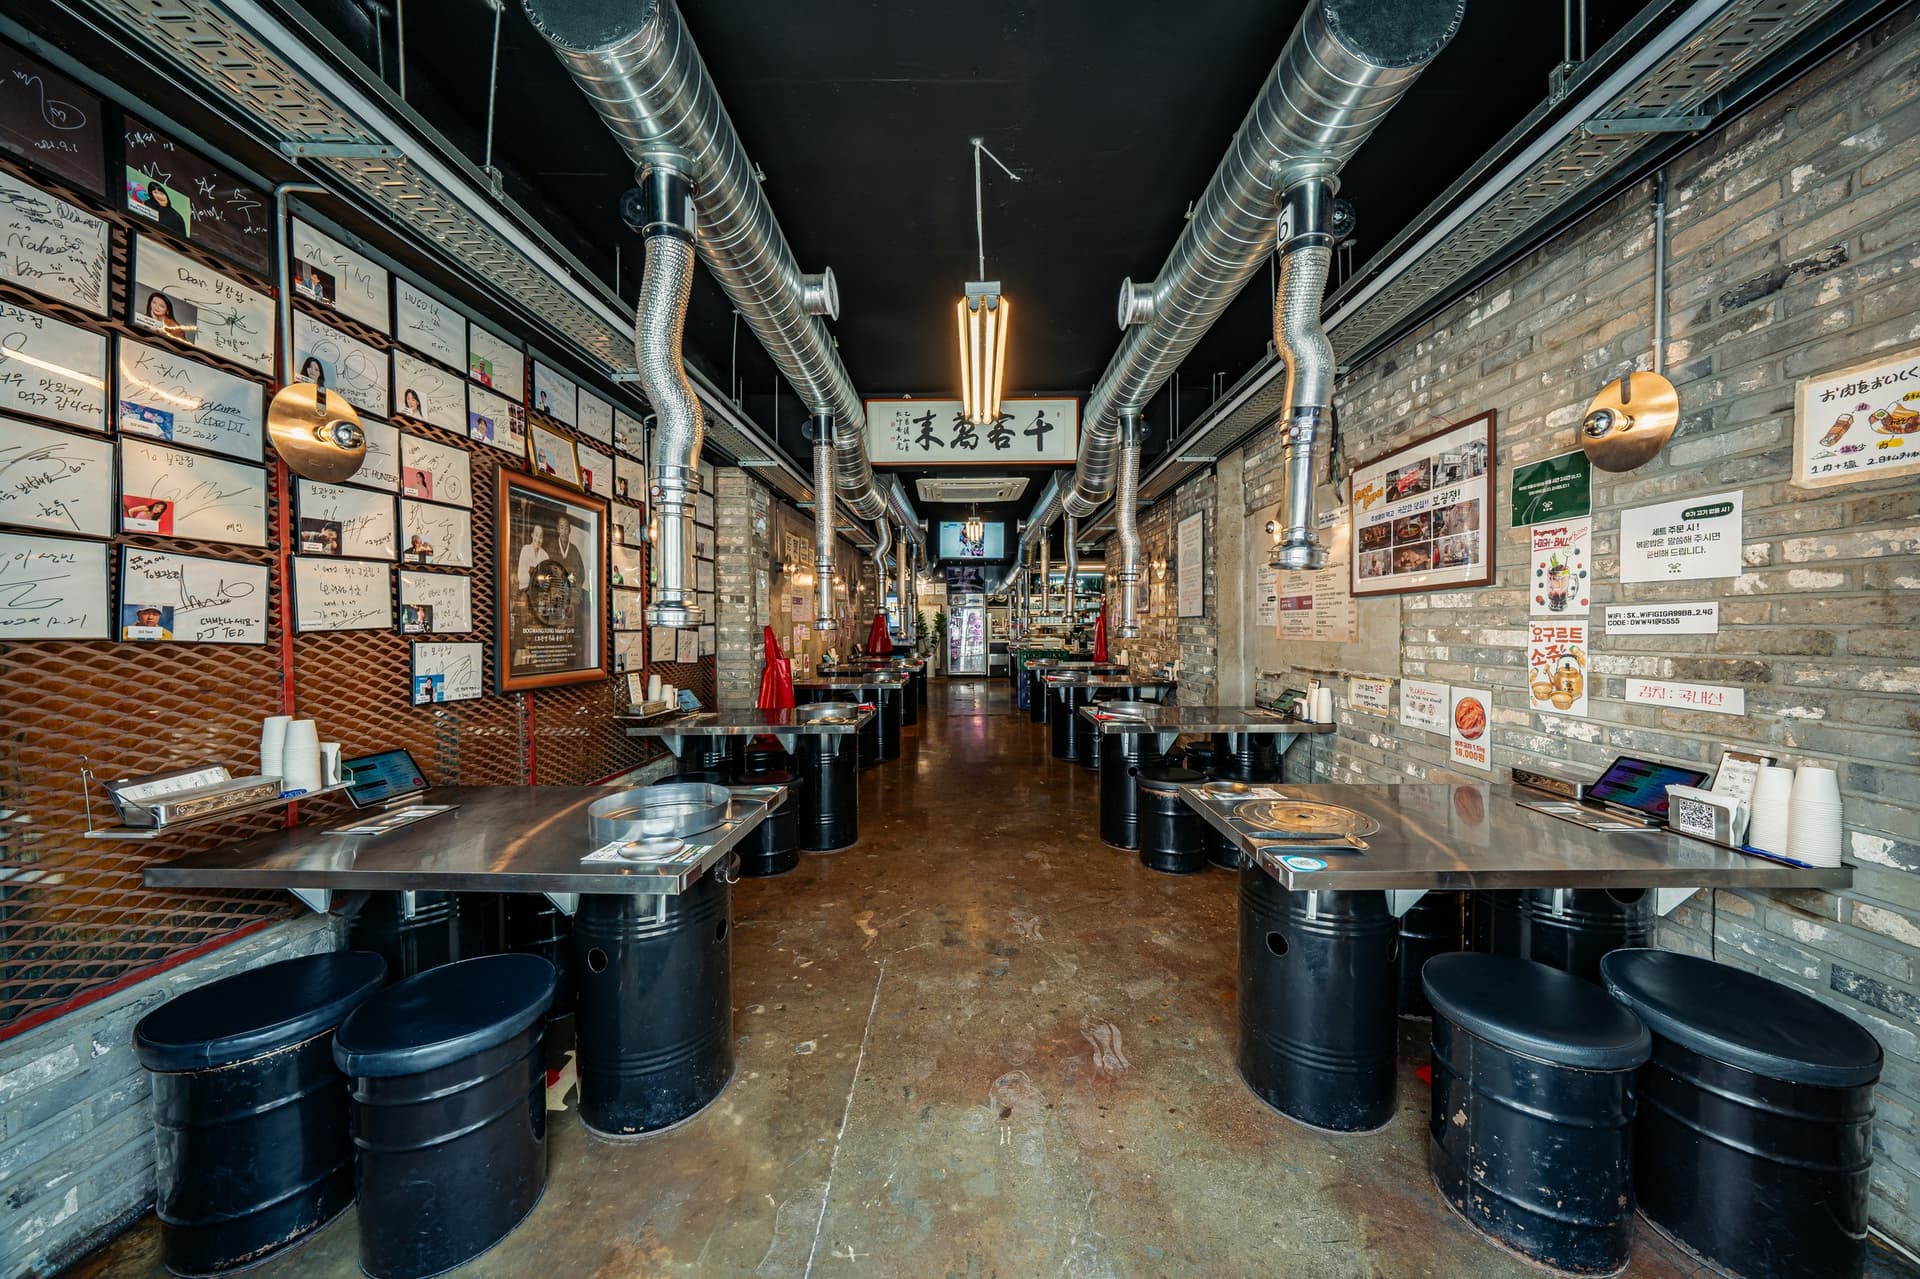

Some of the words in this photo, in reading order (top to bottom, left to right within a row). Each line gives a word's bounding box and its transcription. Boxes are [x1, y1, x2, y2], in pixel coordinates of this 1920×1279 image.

[1819, 365, 1920, 403] お肉をおいしく
[1652, 526, 1667, 536] 세트
[1668, 524, 1685, 534] 주문
[1686, 523, 1695, 532] 시
[1667, 535, 1693, 546] 말씀해
[1694, 532, 1721, 543] 주시면
[1646, 550, 1669, 559] 준비해
[1670, 546, 1707, 557] 드립니다.
[196, 627, 219, 642] DJ
[222, 627, 246, 640] TED
[1531, 627, 1584, 644] 요구르트
[1531, 644, 1561, 667] 소주
[1640, 685, 1665, 700] 김치
[1680, 689, 1723, 707] 국내산
